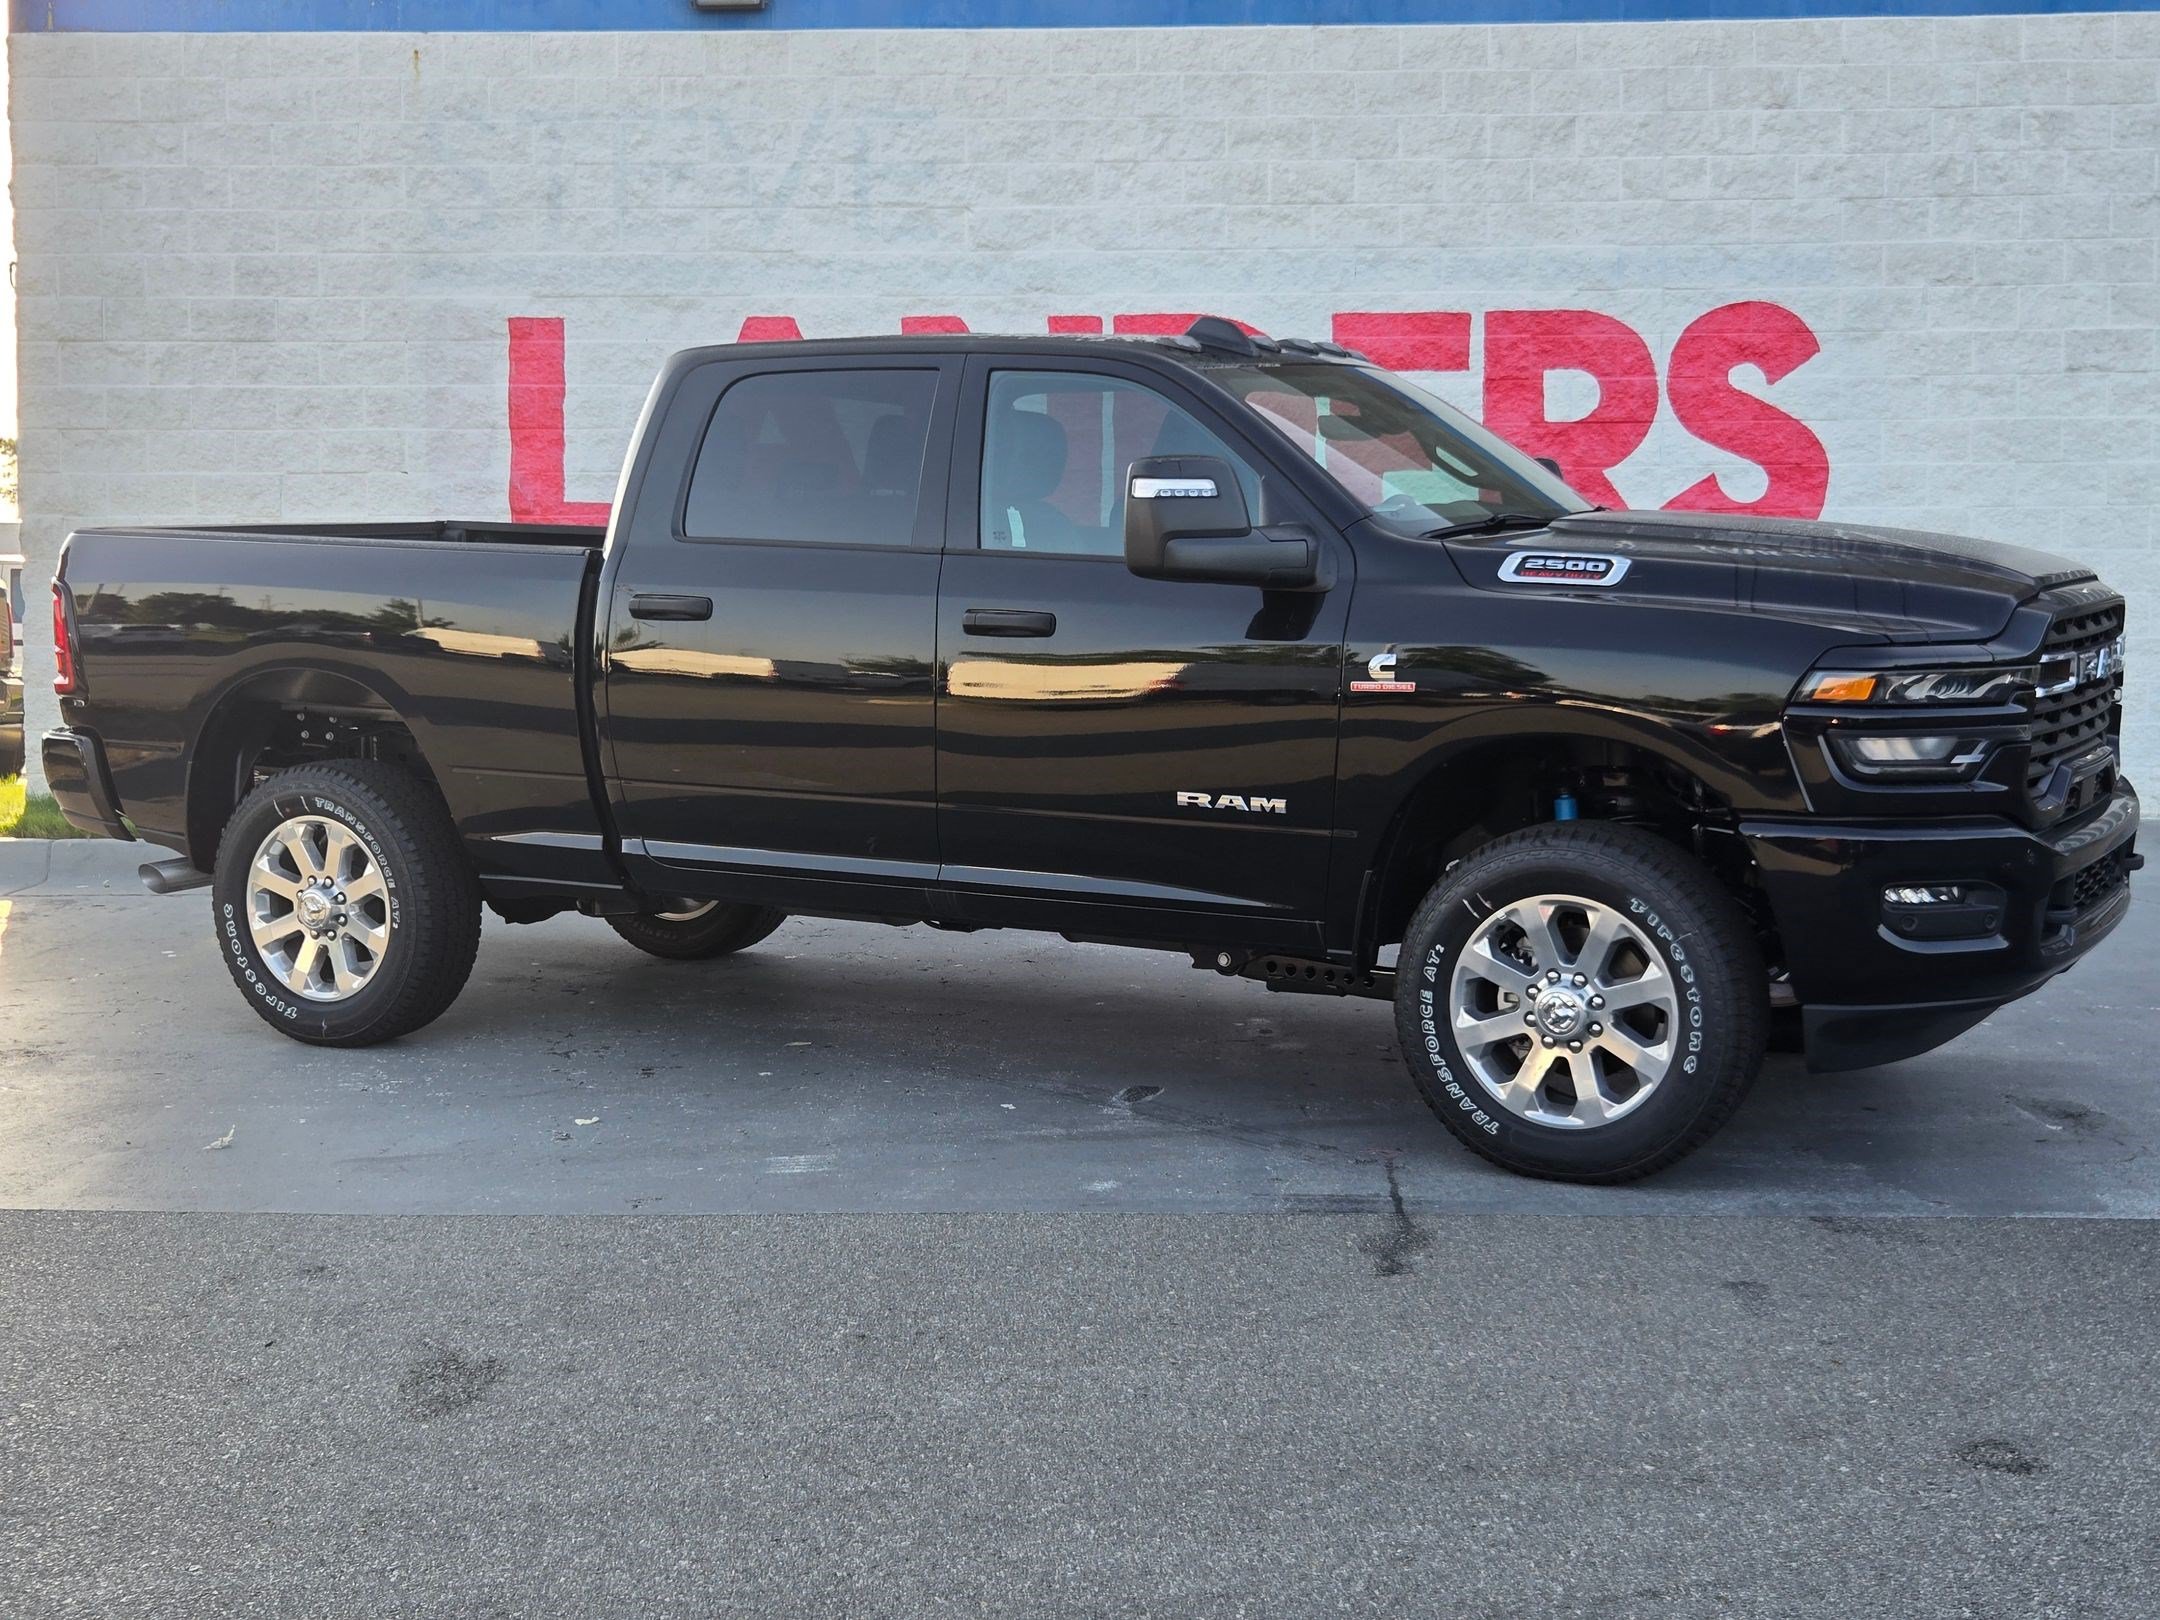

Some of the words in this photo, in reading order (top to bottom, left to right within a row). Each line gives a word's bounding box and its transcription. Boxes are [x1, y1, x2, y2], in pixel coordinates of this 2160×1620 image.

[1525, 559, 1606, 572] 2500
[1177, 791, 1287, 814] RAM
[314, 796, 397, 889] TRANSFORCE
[1420, 989, 1500, 1135] TRANSFORCE
